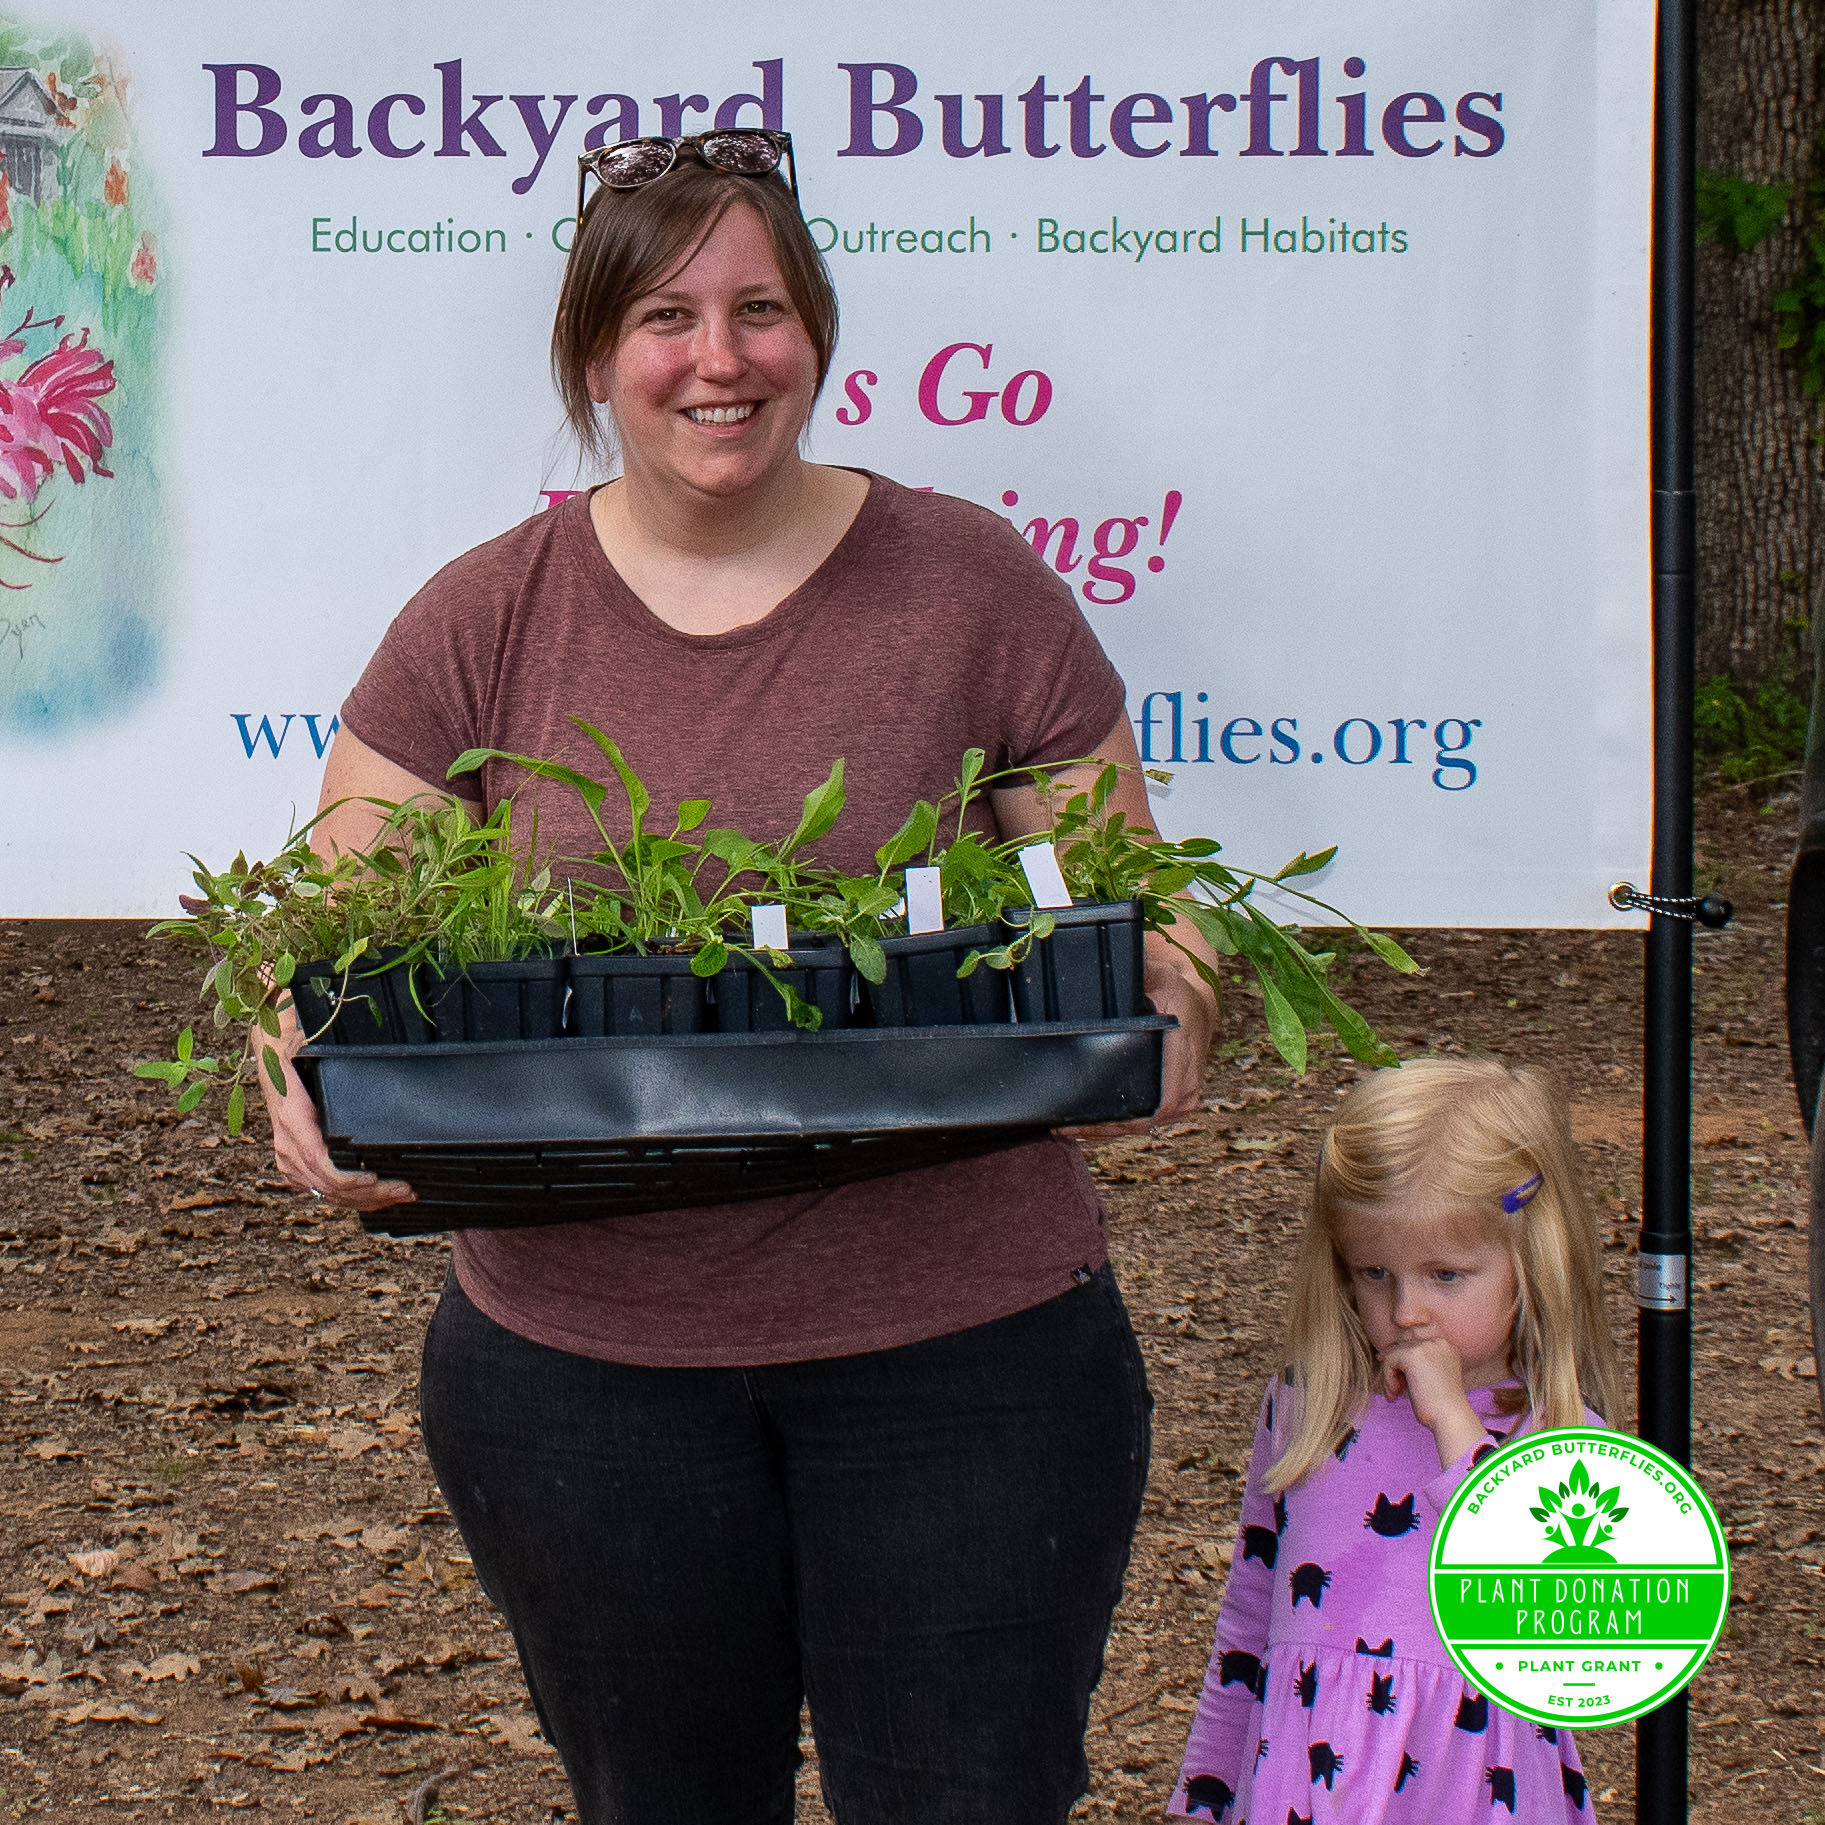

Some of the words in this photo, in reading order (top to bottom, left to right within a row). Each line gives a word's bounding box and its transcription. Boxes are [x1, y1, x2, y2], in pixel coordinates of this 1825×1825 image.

[202, 57, 784, 195] Backyard
[837, 56, 1505, 158] Butterflies
[311, 217, 506, 254] Education
[806, 215, 991, 254] Outreach
[1037, 216, 1222, 262] Backyard
[1241, 216, 1409, 254] Habitats
[918, 342, 1053, 427] Go
